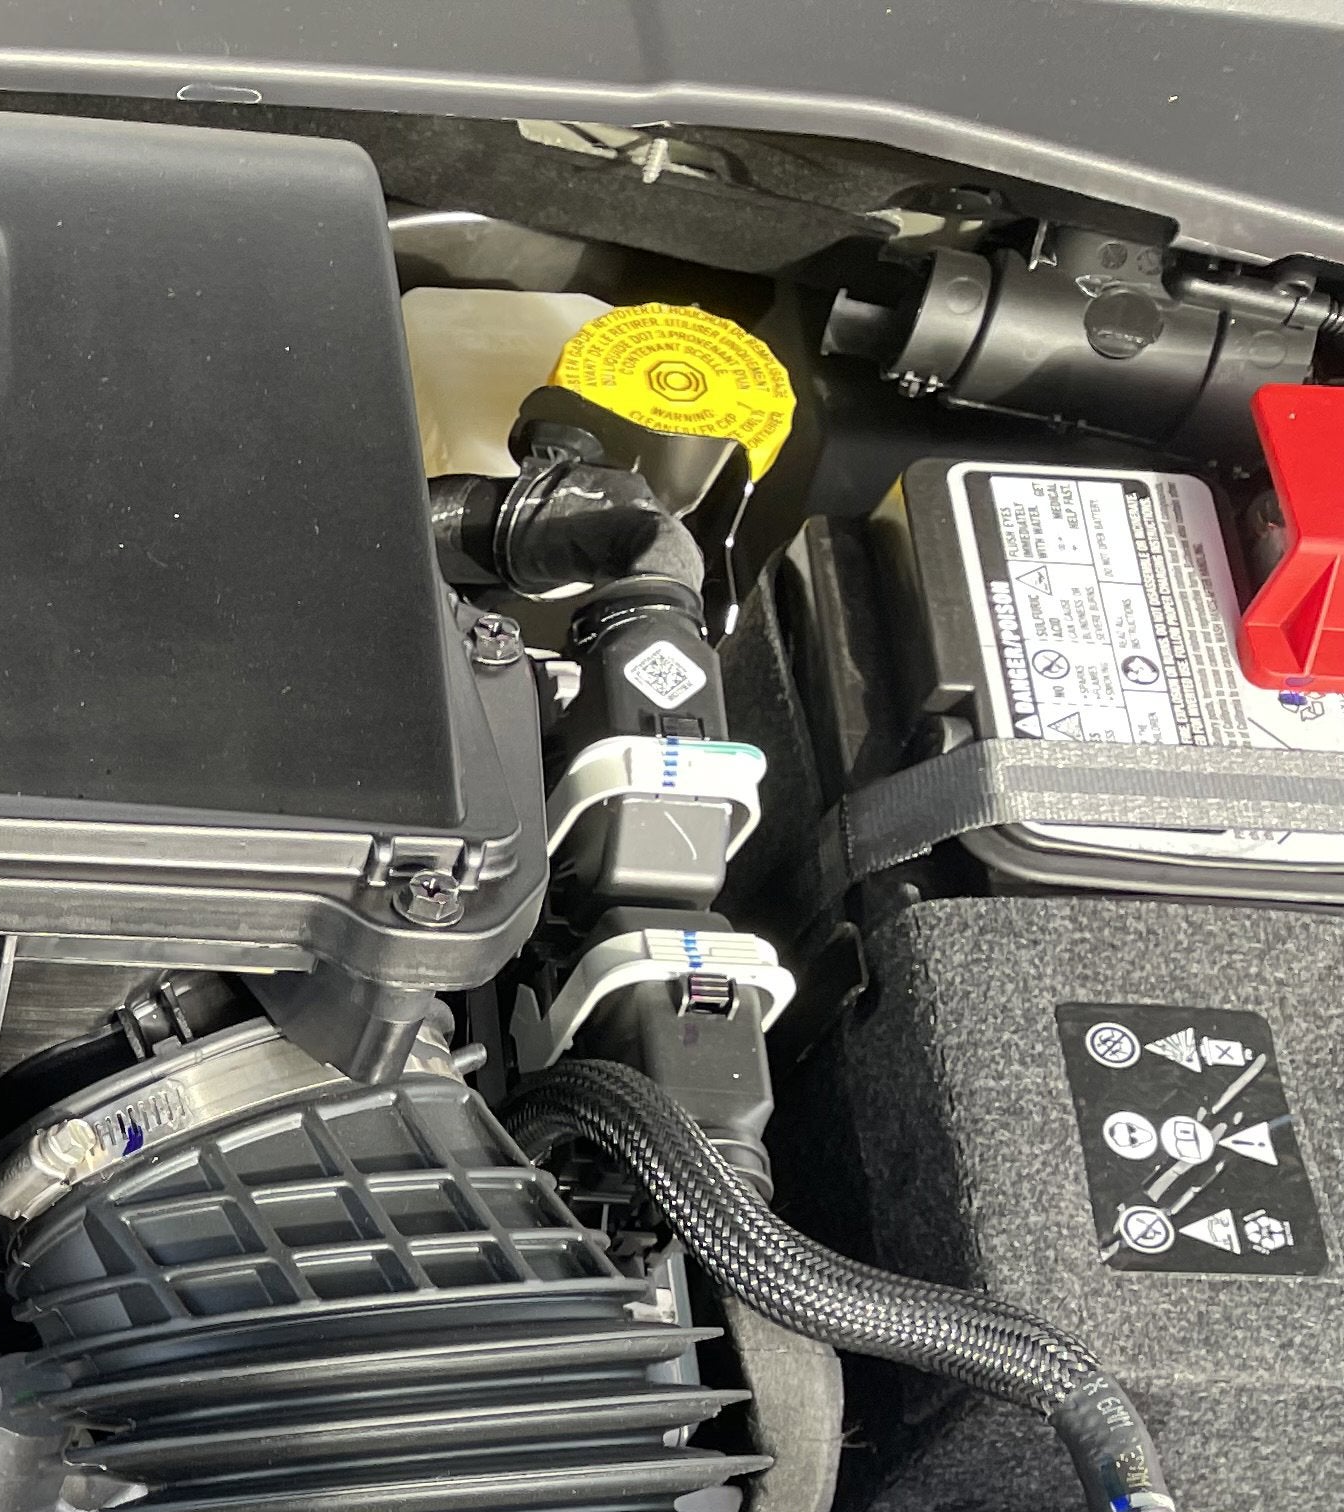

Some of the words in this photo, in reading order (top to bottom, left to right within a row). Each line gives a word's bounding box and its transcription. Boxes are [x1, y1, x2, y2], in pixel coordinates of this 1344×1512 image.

[631, 330, 653, 343] DOT
[618, 343, 681, 376] CONTENANT
[1032, 482, 1044, 497] GET
[1049, 484, 1063, 519] MEDICAL
[1001, 507, 1013, 527] EYES
[1066, 509, 1079, 529] HELP
[1014, 502, 1032, 558] IMMEDIATELY
[1004, 532, 1017, 557] FLUSH
[1035, 538, 1047, 558] WITH
[1029, 594, 1047, 637] SULFURIC
[1049, 618, 1062, 637] ACID
[990, 580, 1036, 714] DANGER/POISON
